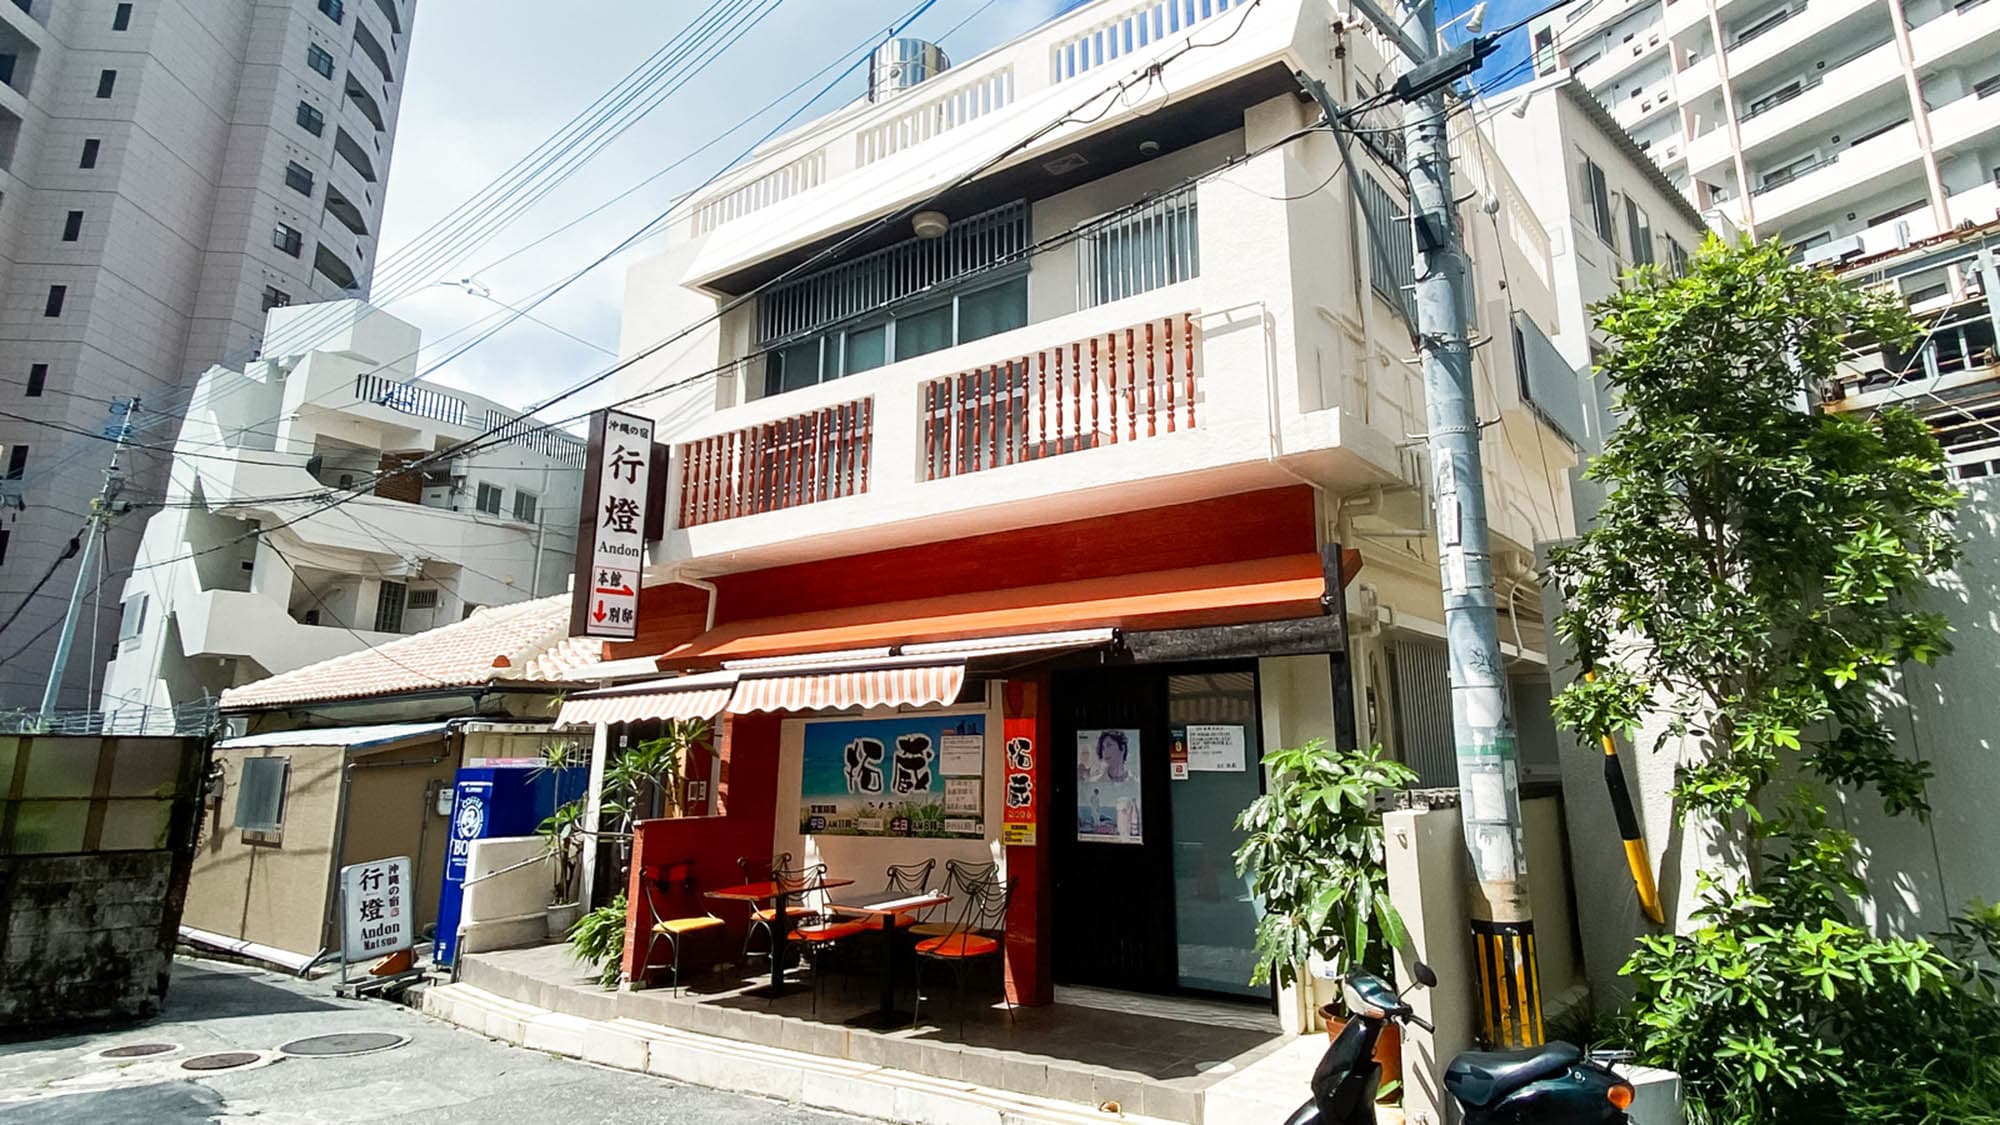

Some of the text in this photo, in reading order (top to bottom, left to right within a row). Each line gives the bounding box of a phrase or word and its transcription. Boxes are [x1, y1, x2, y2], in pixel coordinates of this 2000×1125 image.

[608, 420, 649, 440] 沖縄の宿
[602, 444, 645, 535] 行燈
[598, 540, 640, 557] Andon
[597, 569, 622, 587] 本館
[608, 607, 633, 624] 別邸
[359, 867, 385, 923] 行燈
[388, 863, 400, 908] 沖縄の宿
[360, 922, 400, 941] Andon
